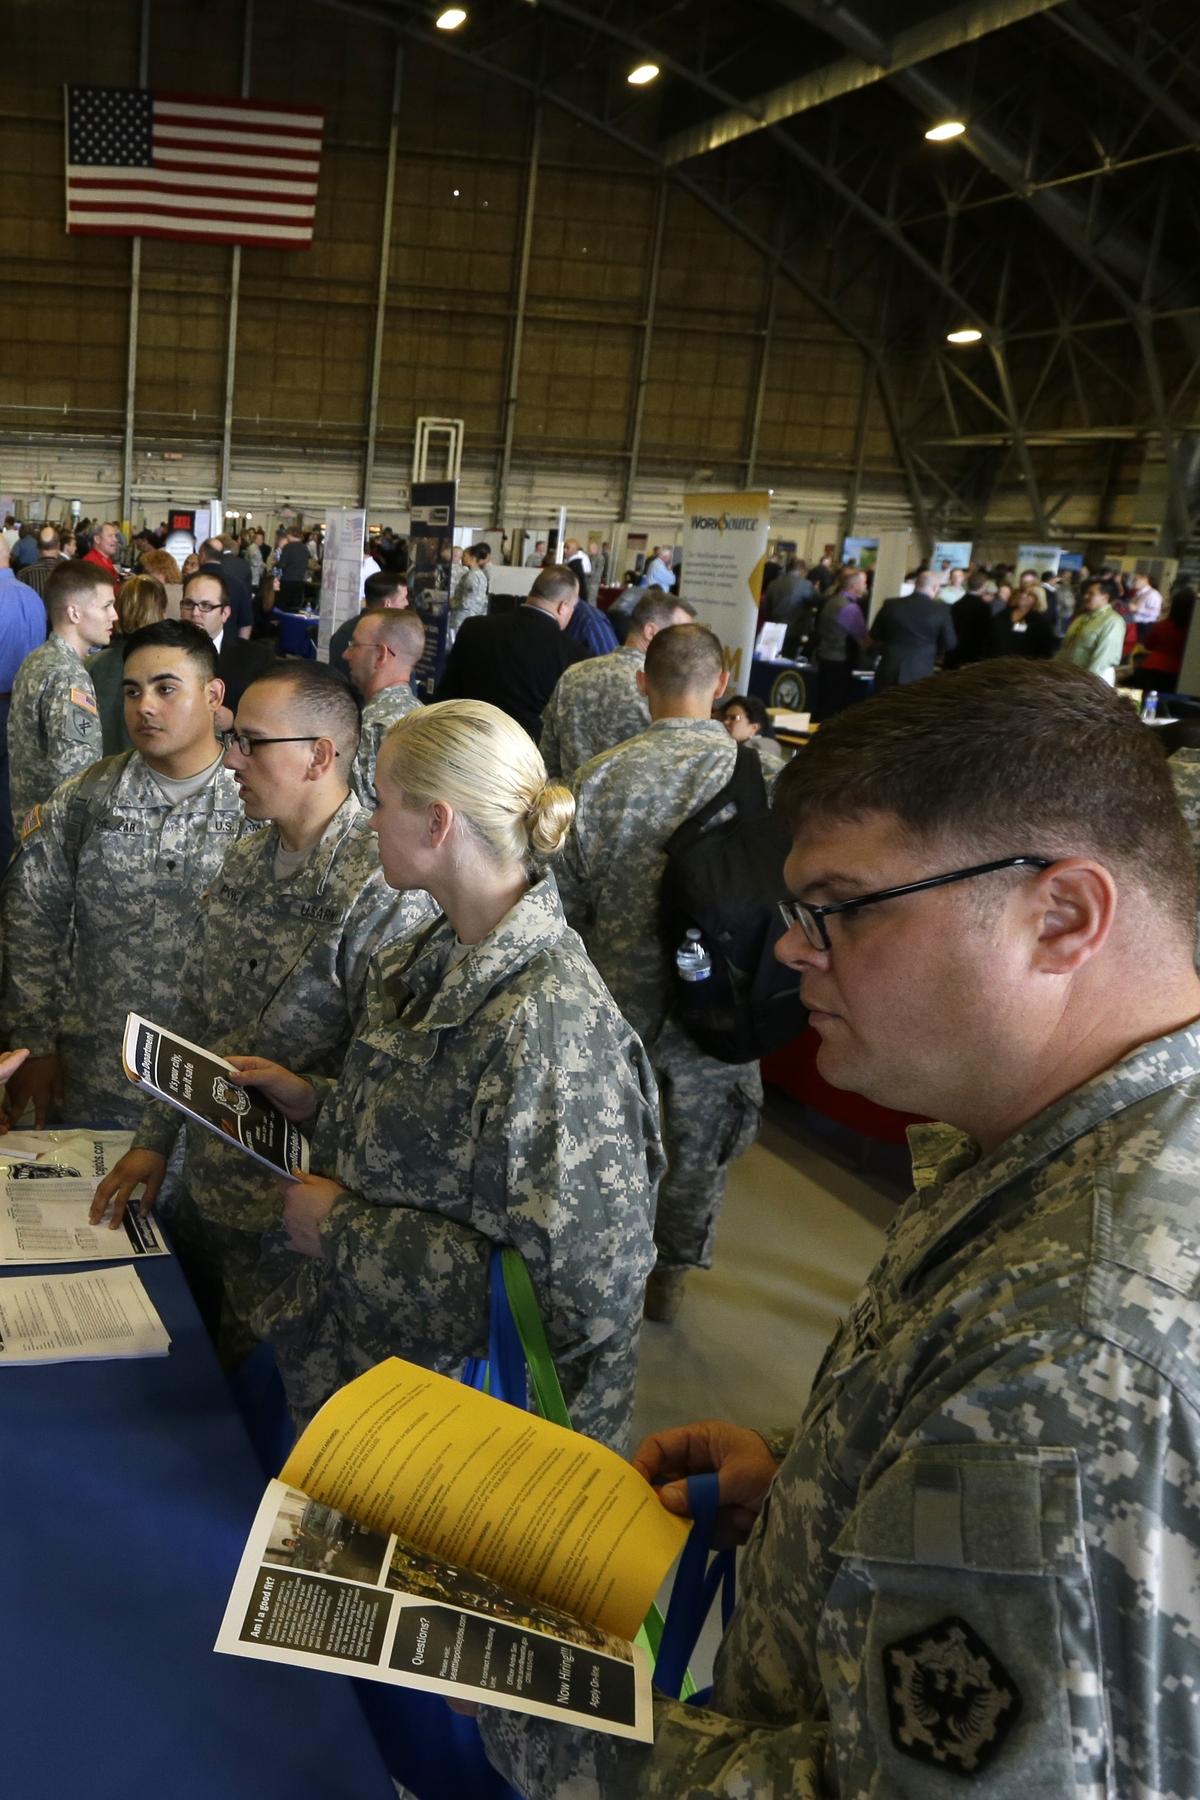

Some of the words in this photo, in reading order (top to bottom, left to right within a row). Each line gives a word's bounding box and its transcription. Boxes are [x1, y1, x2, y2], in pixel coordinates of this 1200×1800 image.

[143, 1033, 153, 1069] Department
[185, 1063, 193, 1078] safe
[183, 1084, 192, 1099] Keep
[264, 1577, 274, 1590] fit?
[260, 1592, 270, 1611] good
[251, 1624, 261, 1637] Am
[411, 1617, 430, 1665] Questions?
[450, 1614, 467, 1680] seattlepolicejobs.com
[558, 1647, 575, 1681] Hiring!!!
[557, 1682, 570, 1704] Now
[589, 1687, 600, 1708] Apply
